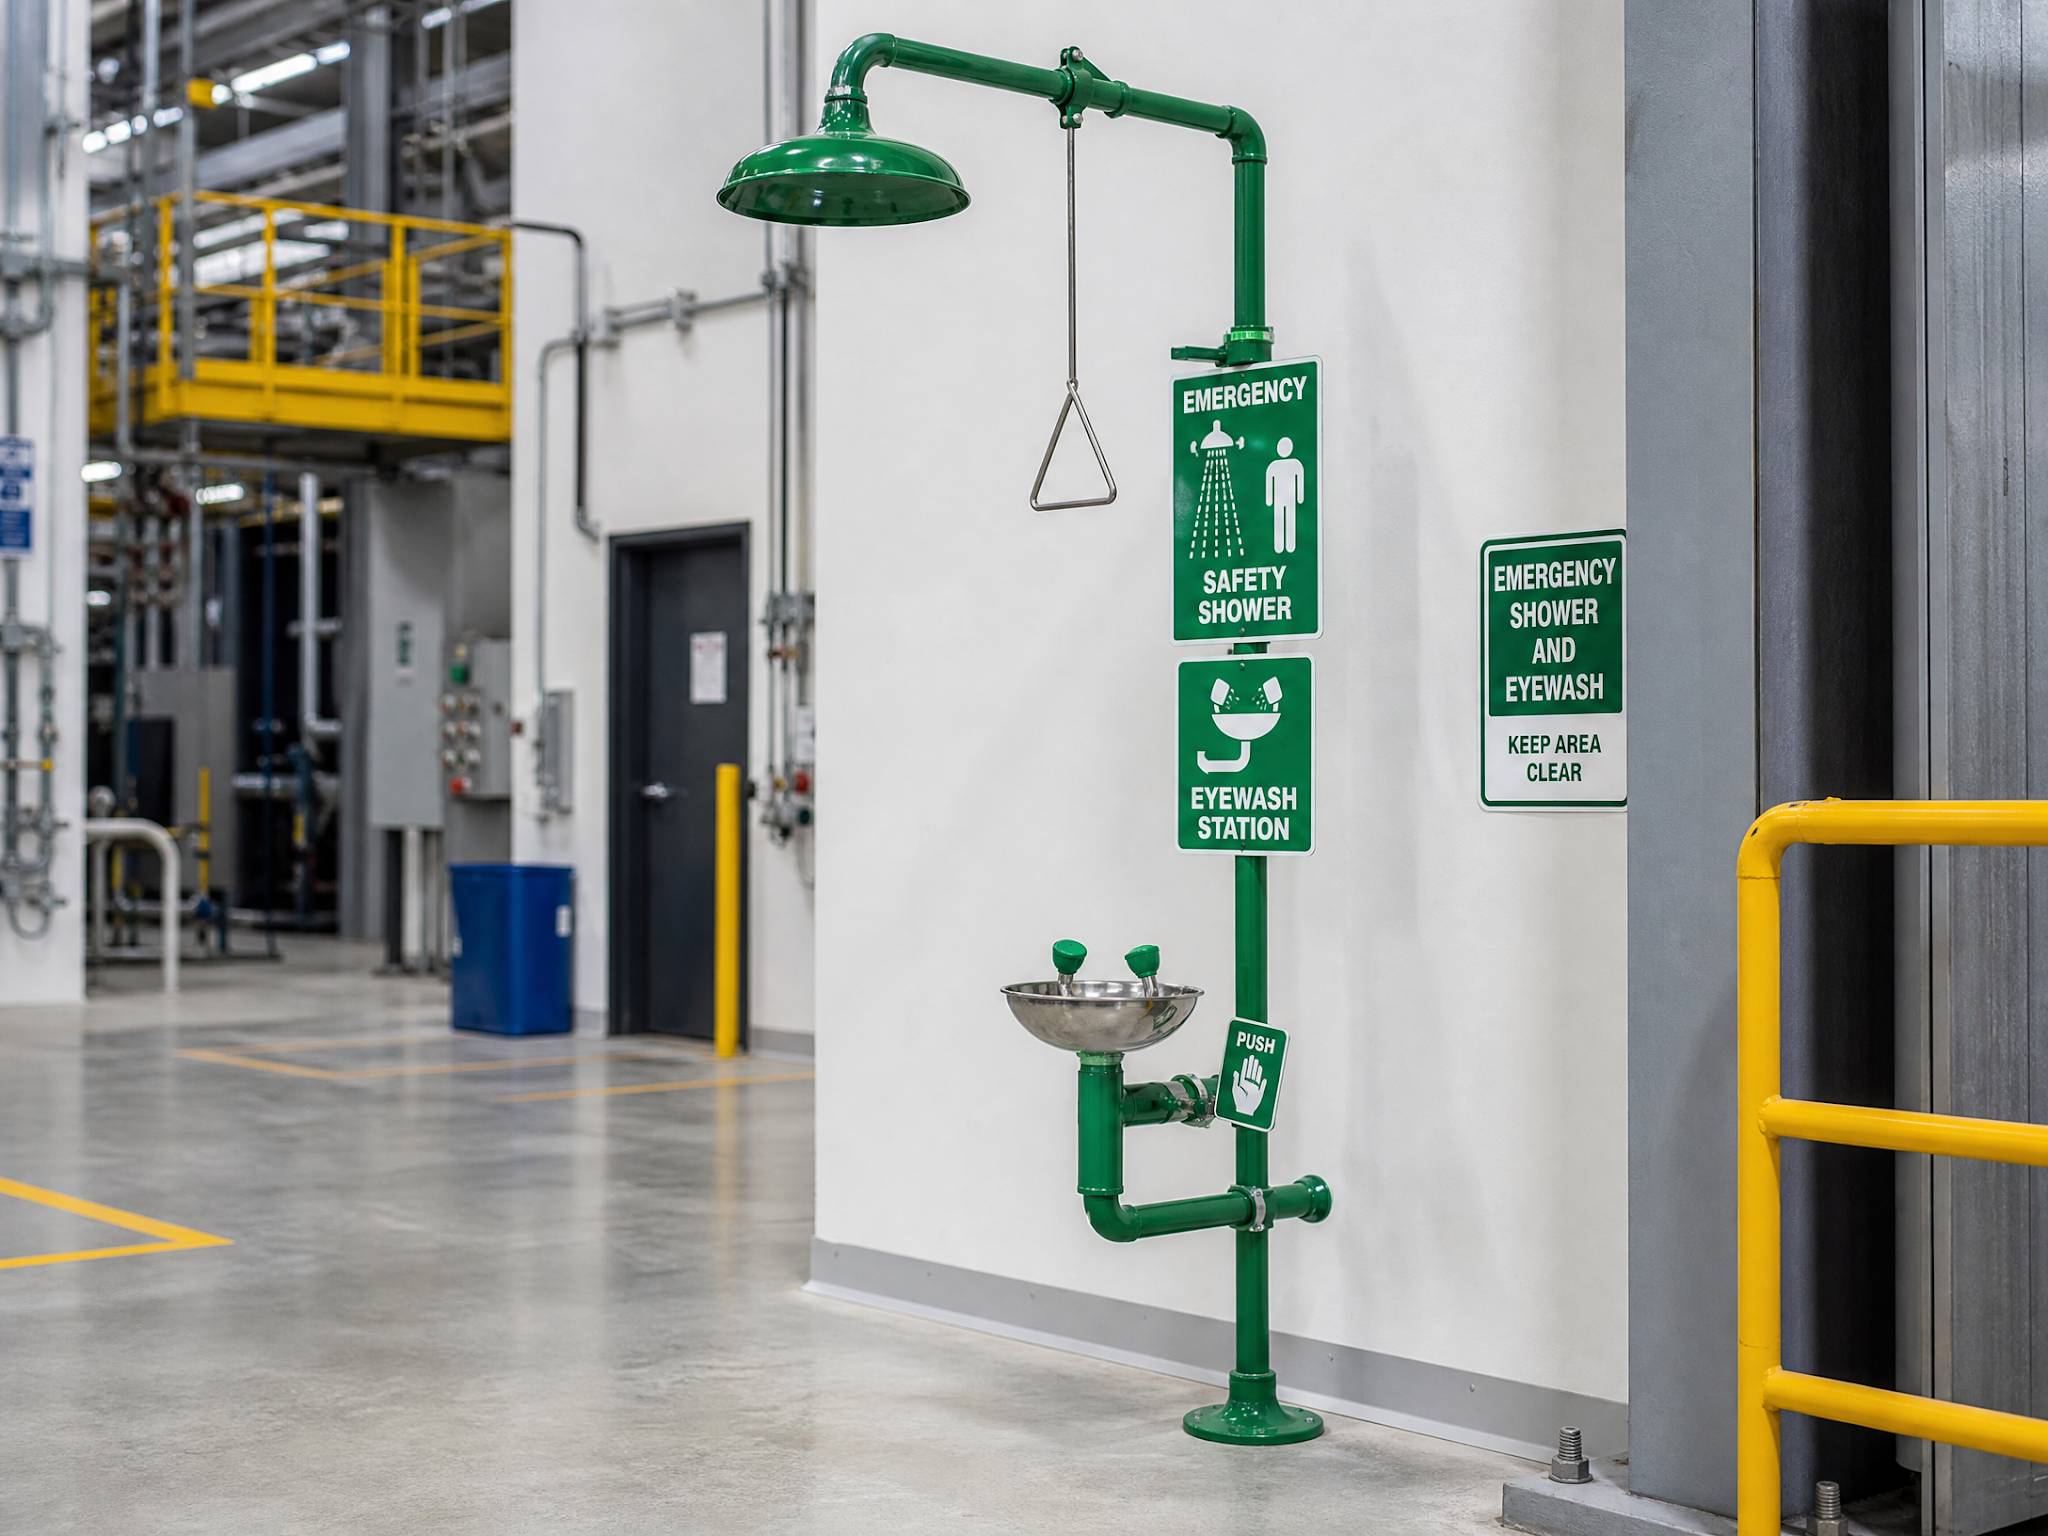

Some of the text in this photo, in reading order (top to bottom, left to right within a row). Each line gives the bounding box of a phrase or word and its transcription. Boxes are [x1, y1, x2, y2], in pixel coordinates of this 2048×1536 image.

[1183, 375, 1307, 414] EMERGENCY
[1203, 565, 1287, 594] SAFETY
[1494, 557, 1617, 592] EMERGENCY
[1198, 596, 1292, 625] SHOWER
[1509, 597, 1599, 629] SHOWER
[1531, 636, 1576, 664] AND
[1505, 673, 1604, 702] EYEWASH
[1508, 734, 1602, 755] KEEP AREA
[1526, 762, 1582, 782] CLEAR
[1191, 786, 1297, 811] EYEWASH
[1197, 815, 1290, 841] STATION
[1236, 1031, 1276, 1054] PUSH
